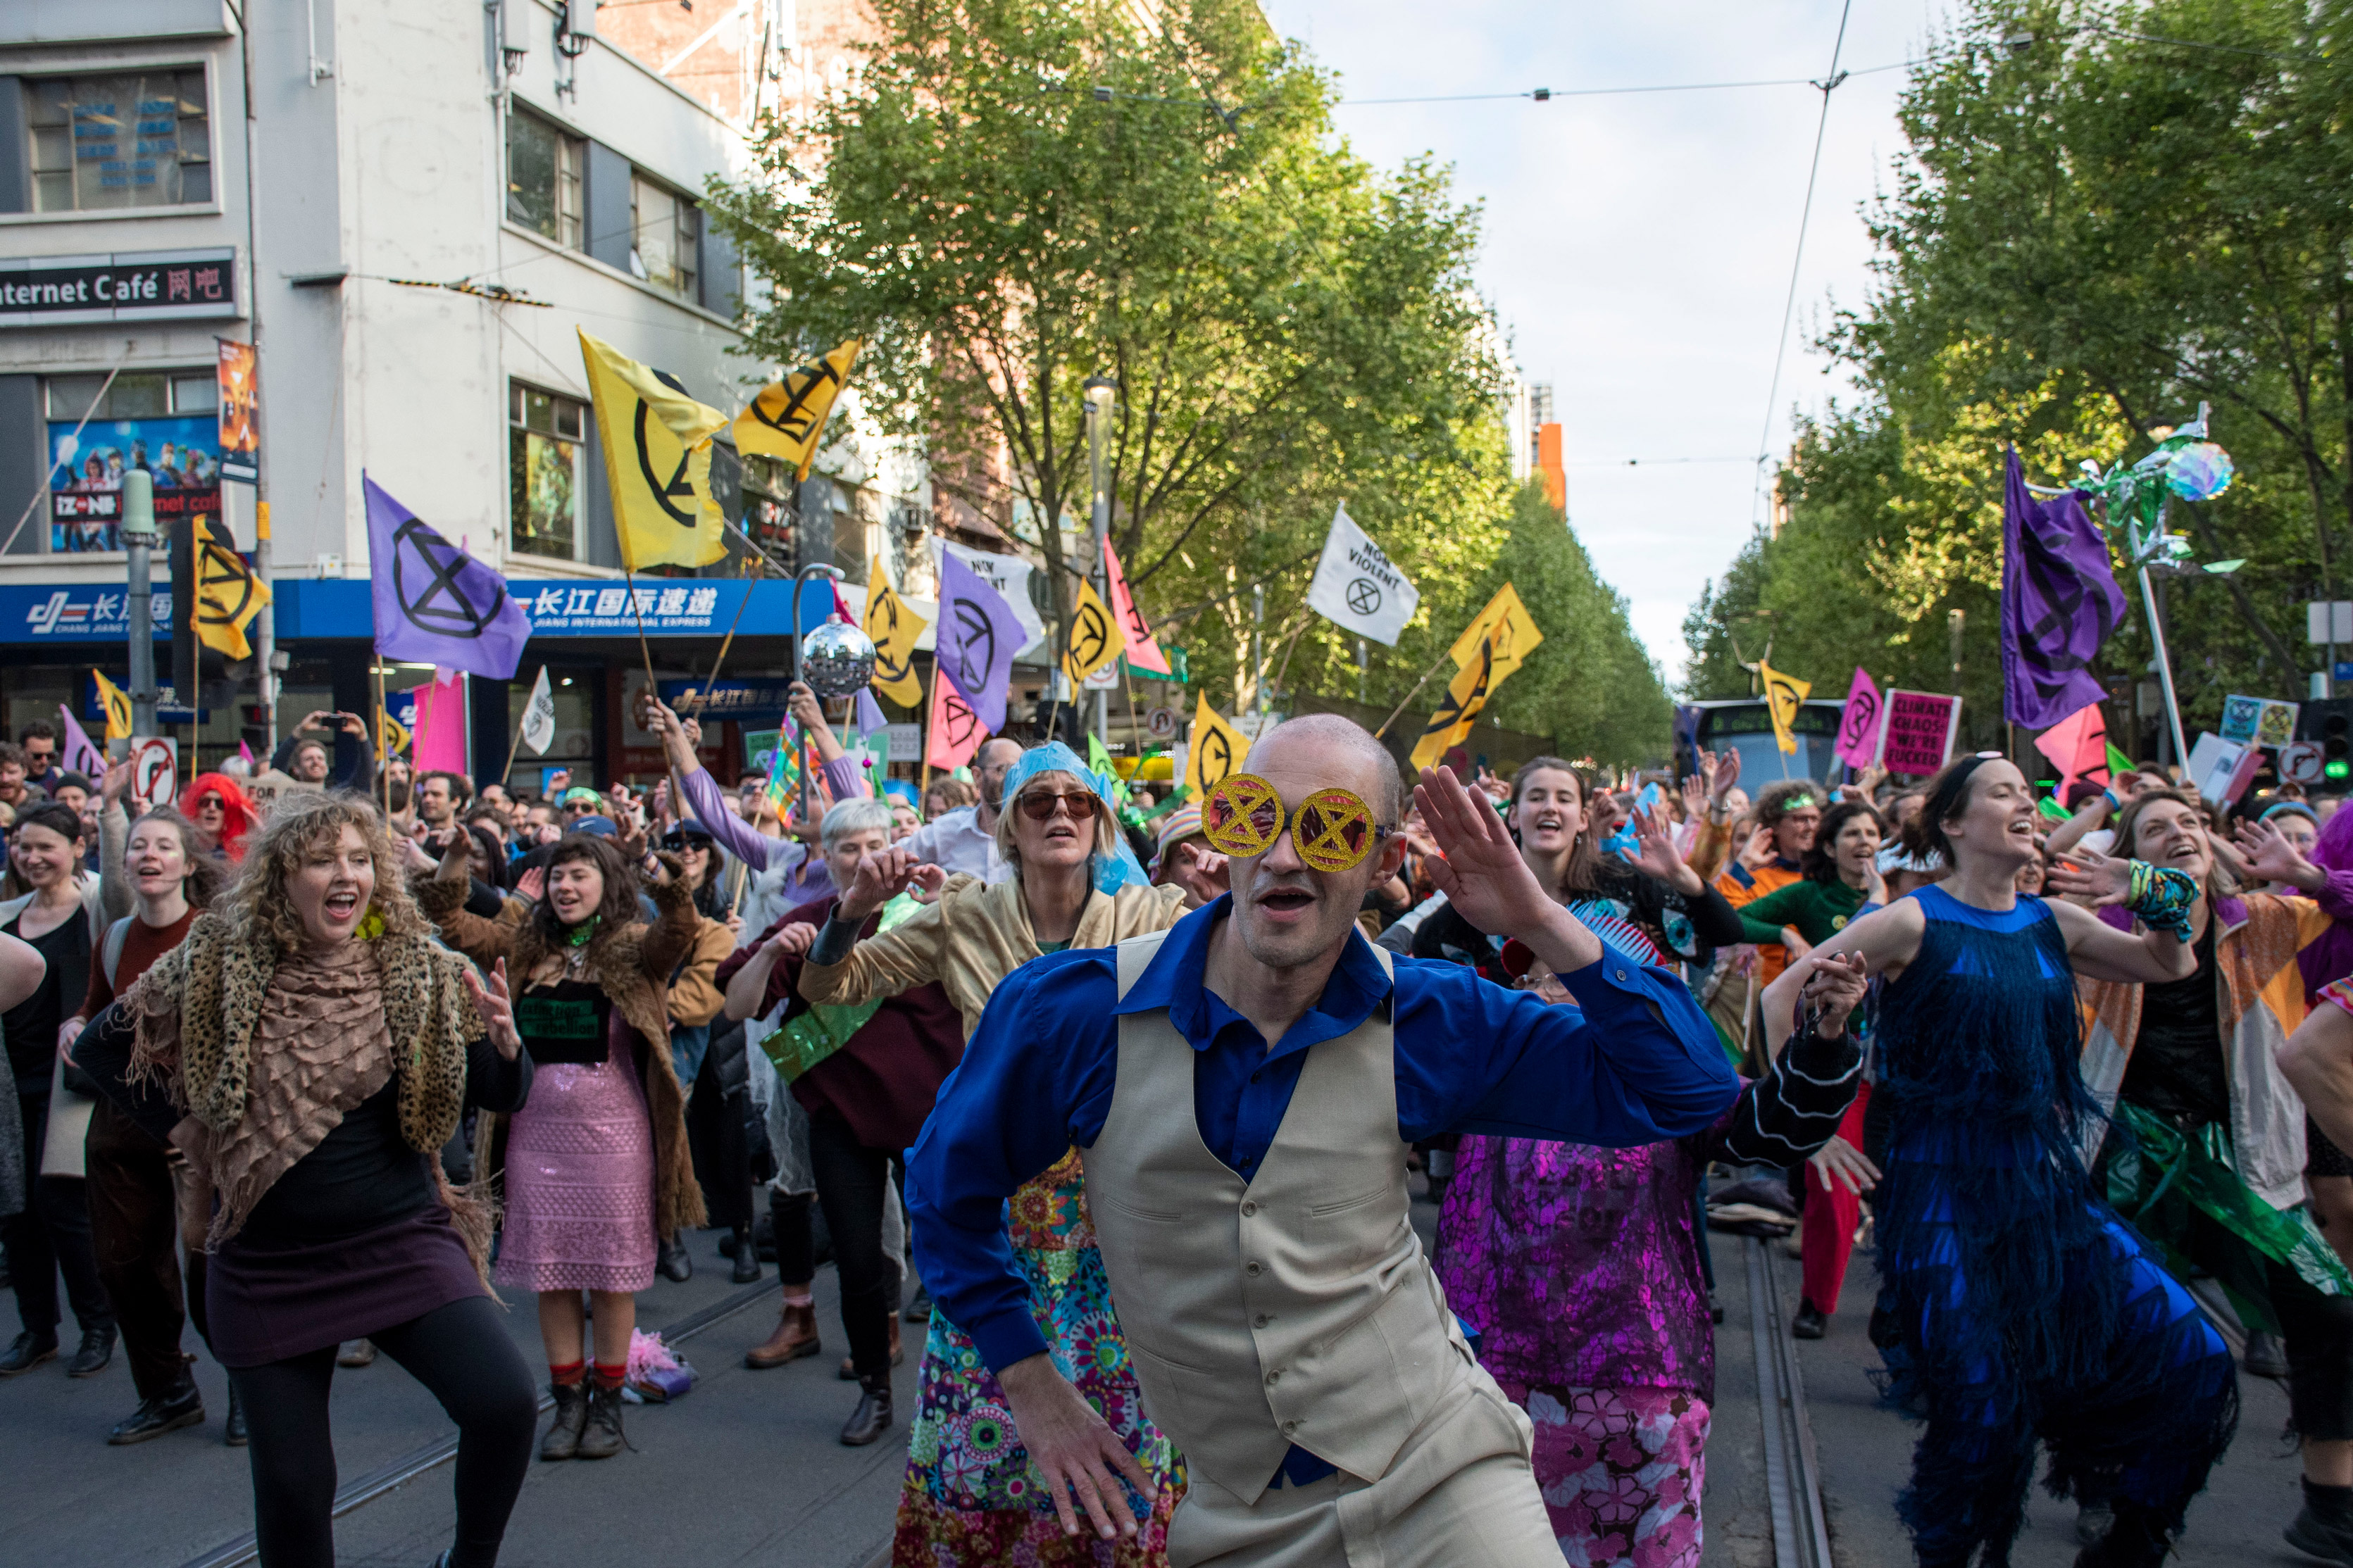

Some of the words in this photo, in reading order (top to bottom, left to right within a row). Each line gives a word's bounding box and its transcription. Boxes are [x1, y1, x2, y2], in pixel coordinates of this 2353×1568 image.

[0, 278, 88, 305] ternet
[94, 270, 159, 301] Café
[189, 491, 222, 511] caf
[1363, 541, 1390, 568] NON
[1349, 548, 1400, 589] VIOLENT
[534, 587, 718, 617] 长江国际速递
[54, 623, 90, 634] CHANG
[92, 623, 123, 633] JIANG
[534, 617, 569, 628] JIANG
[661, 616, 712, 627] EXPRESS
[1894, 699, 1951, 717] CLIMATE
[1897, 734, 1937, 749] WE'RE
[1887, 748, 1940, 766] FUCKED
[247, 785, 275, 799] FOR
